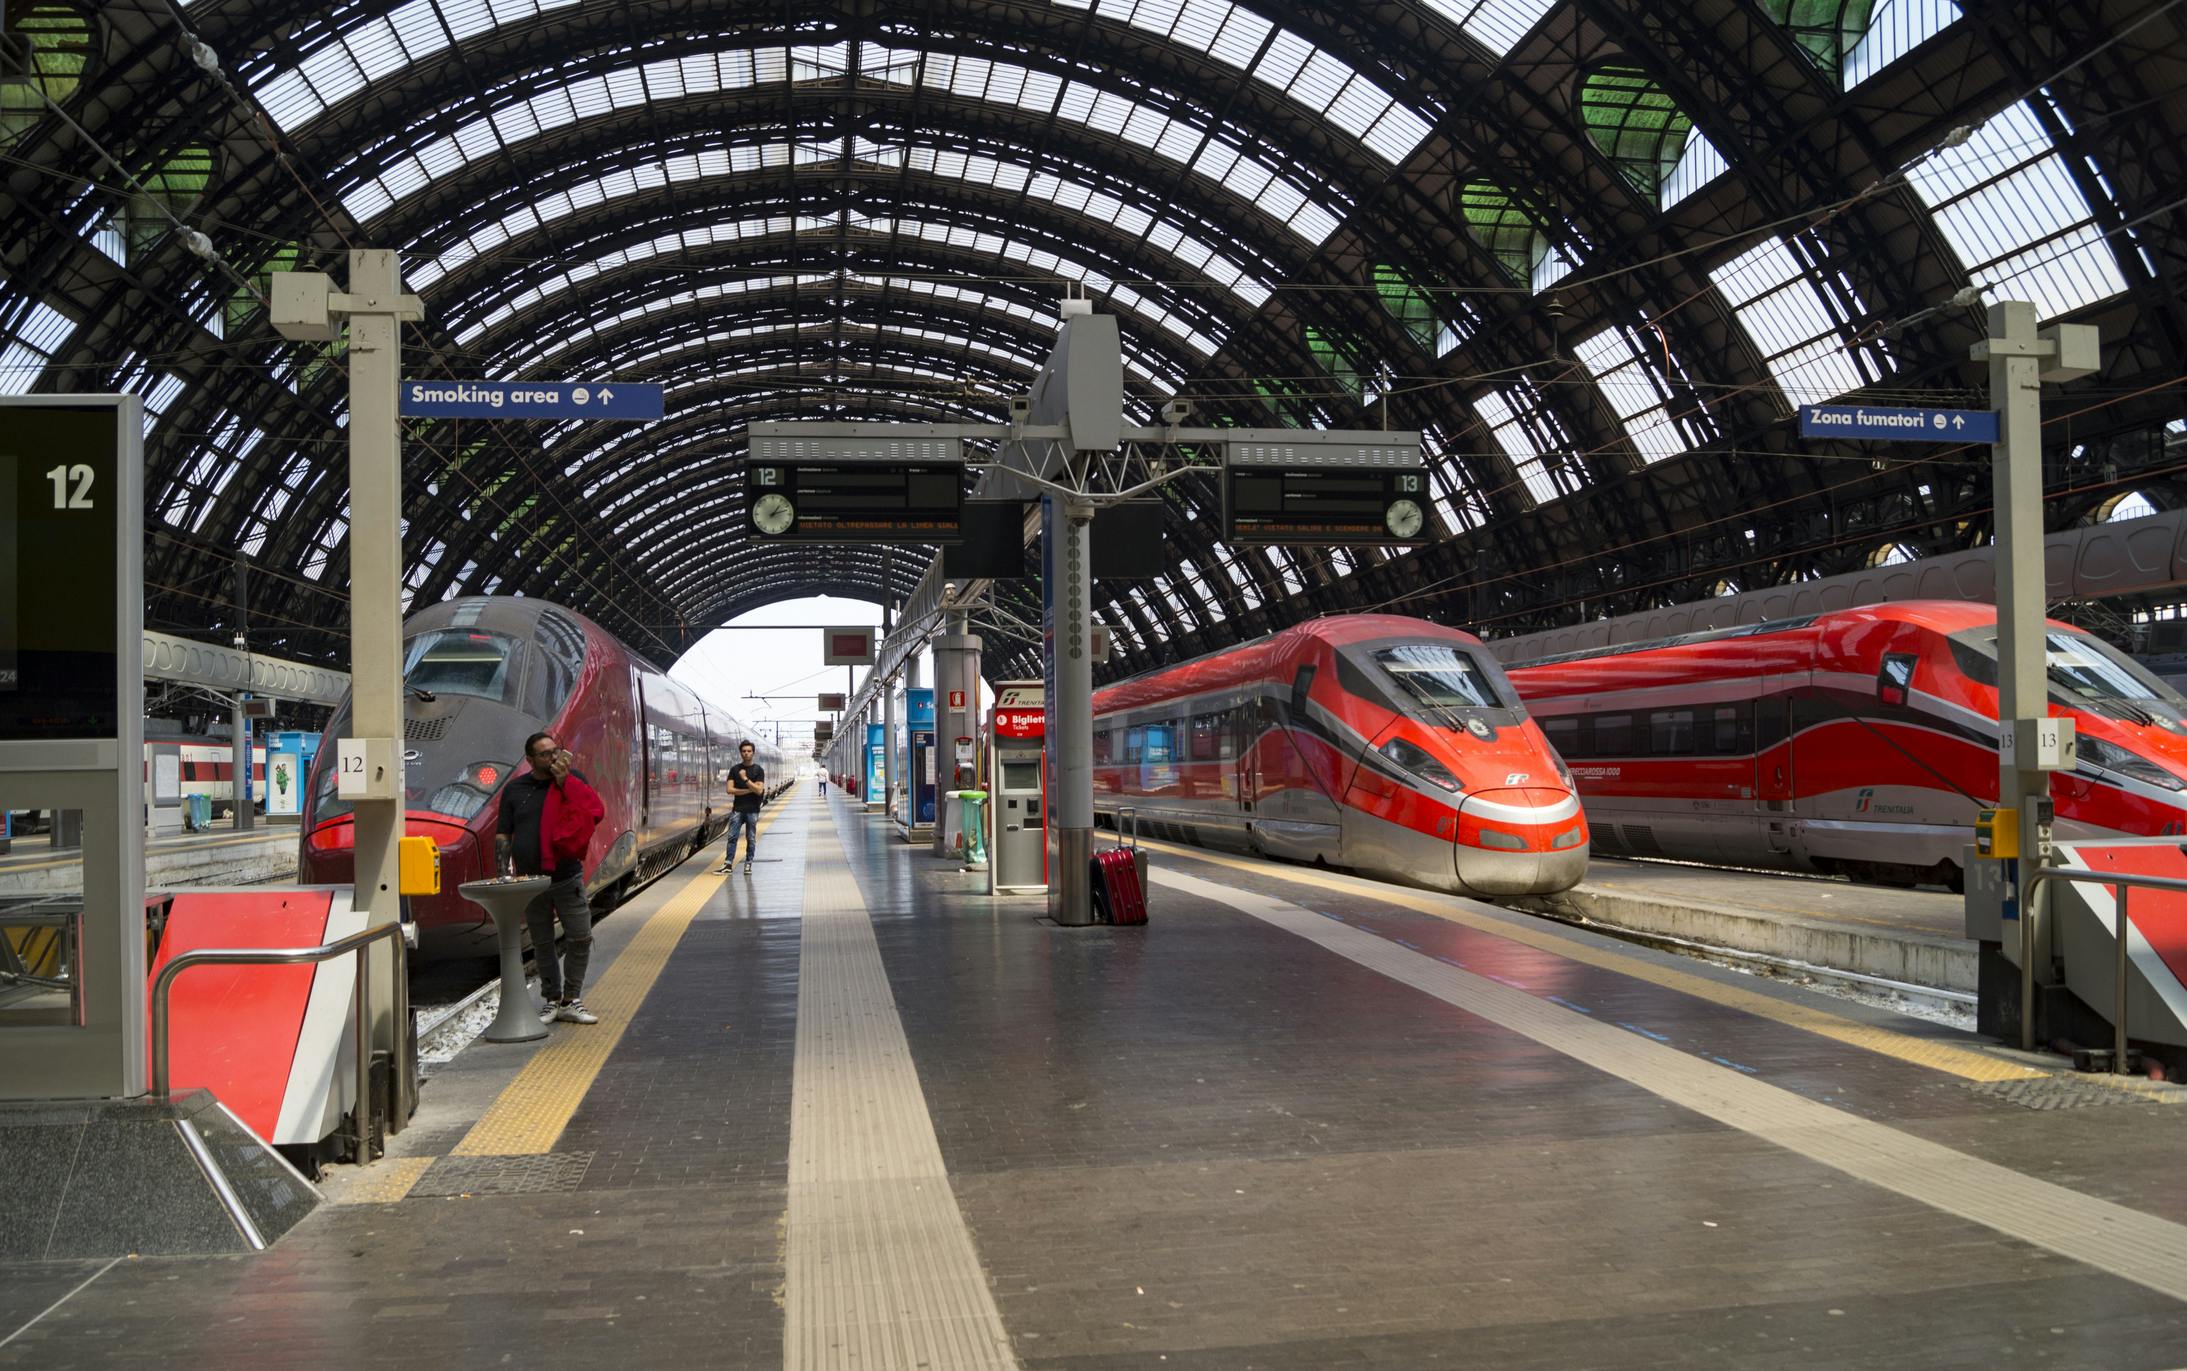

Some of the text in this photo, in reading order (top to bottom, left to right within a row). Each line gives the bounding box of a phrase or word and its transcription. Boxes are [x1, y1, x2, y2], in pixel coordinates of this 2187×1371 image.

[411, 385, 559, 407] Smoking area
[1811, 409, 1925, 428] Zona fumatori
[758, 467, 777, 486] 12
[1401, 475, 1418, 492] 13
[47, 463, 95, 509] 12
[2001, 734, 2014, 749] 13
[2041, 733, 2057, 748] 13
[343, 756, 364, 773] 12
[1873, 804, 1914, 814] TRENITALIA
